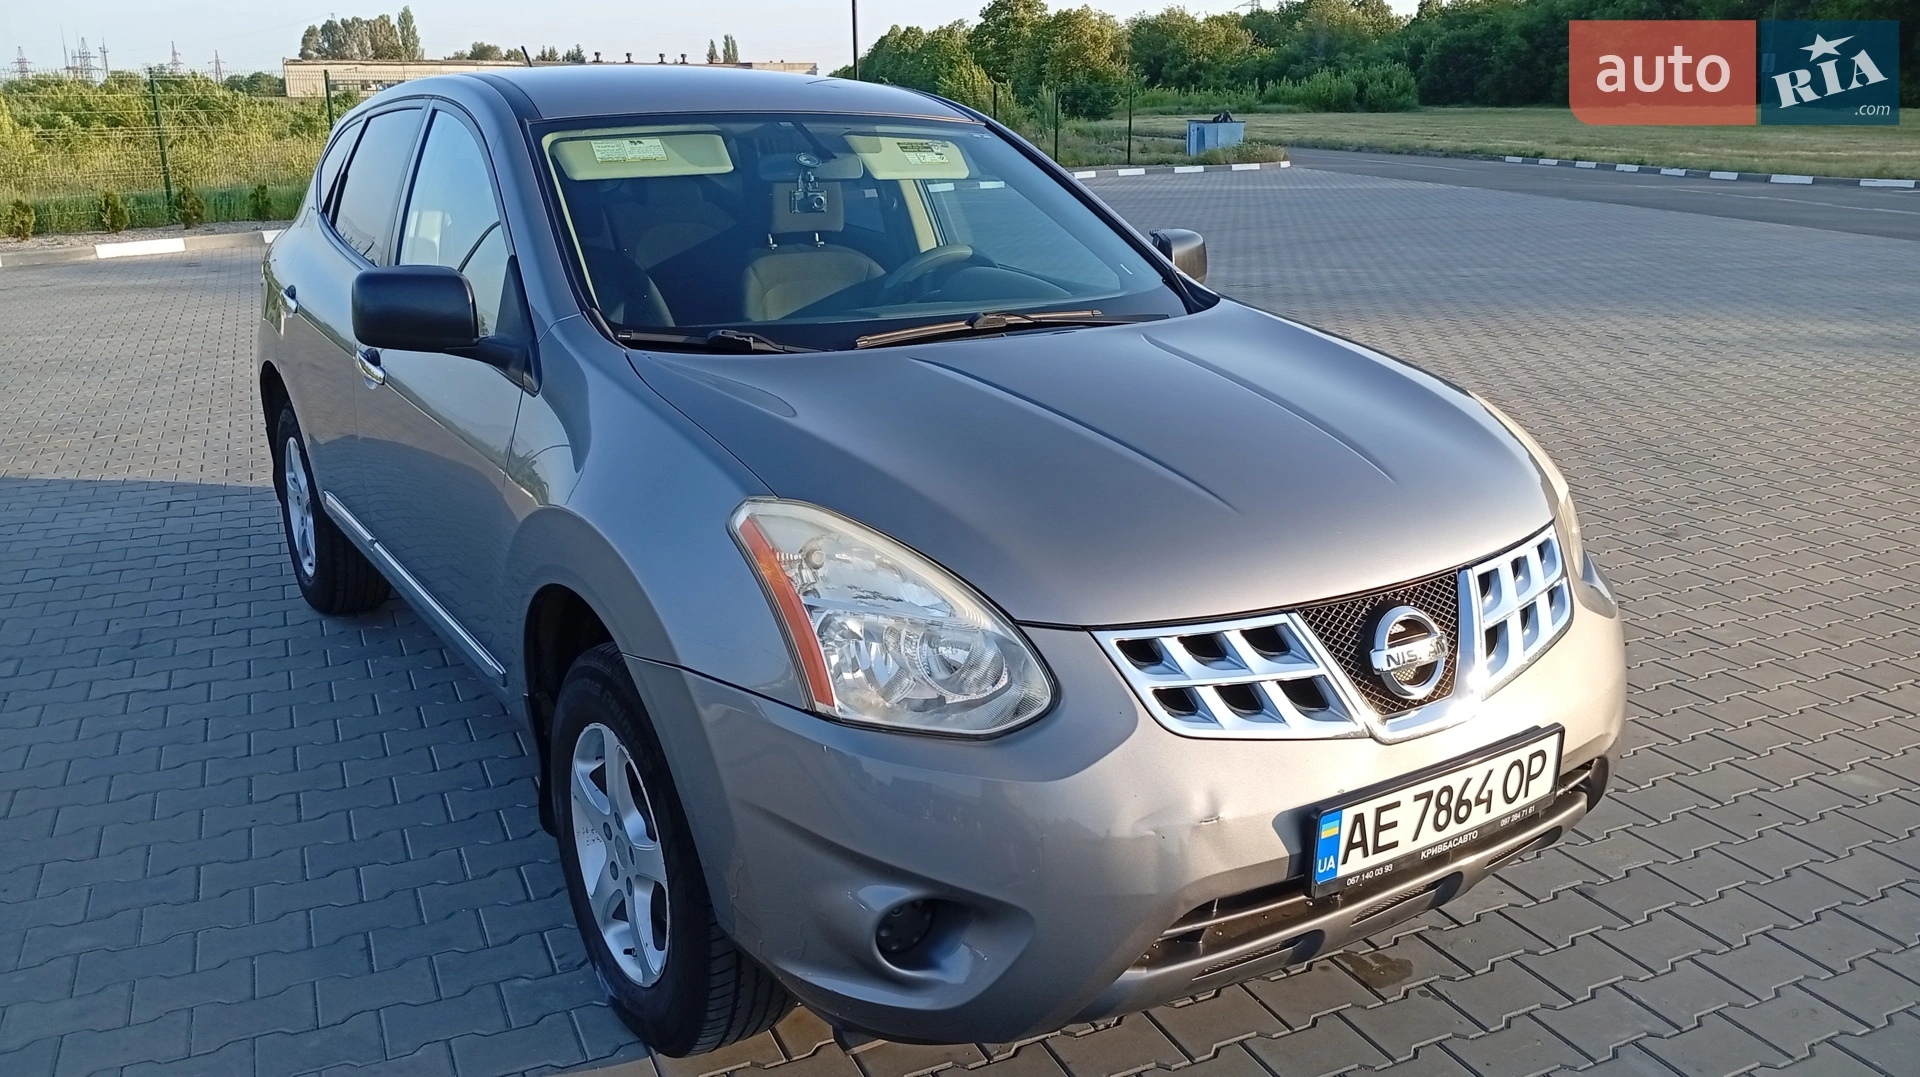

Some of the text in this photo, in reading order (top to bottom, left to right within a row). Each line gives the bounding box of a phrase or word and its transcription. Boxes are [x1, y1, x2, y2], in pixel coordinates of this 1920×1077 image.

[1341, 749, 1547, 866] AE 7864 OP
[1420, 830, 1479, 860] КРИВБАСАВТО
[1317, 855, 1336, 873] UA
[1361, 870, 1374, 881] 140
[1384, 863, 1393, 873] 93
